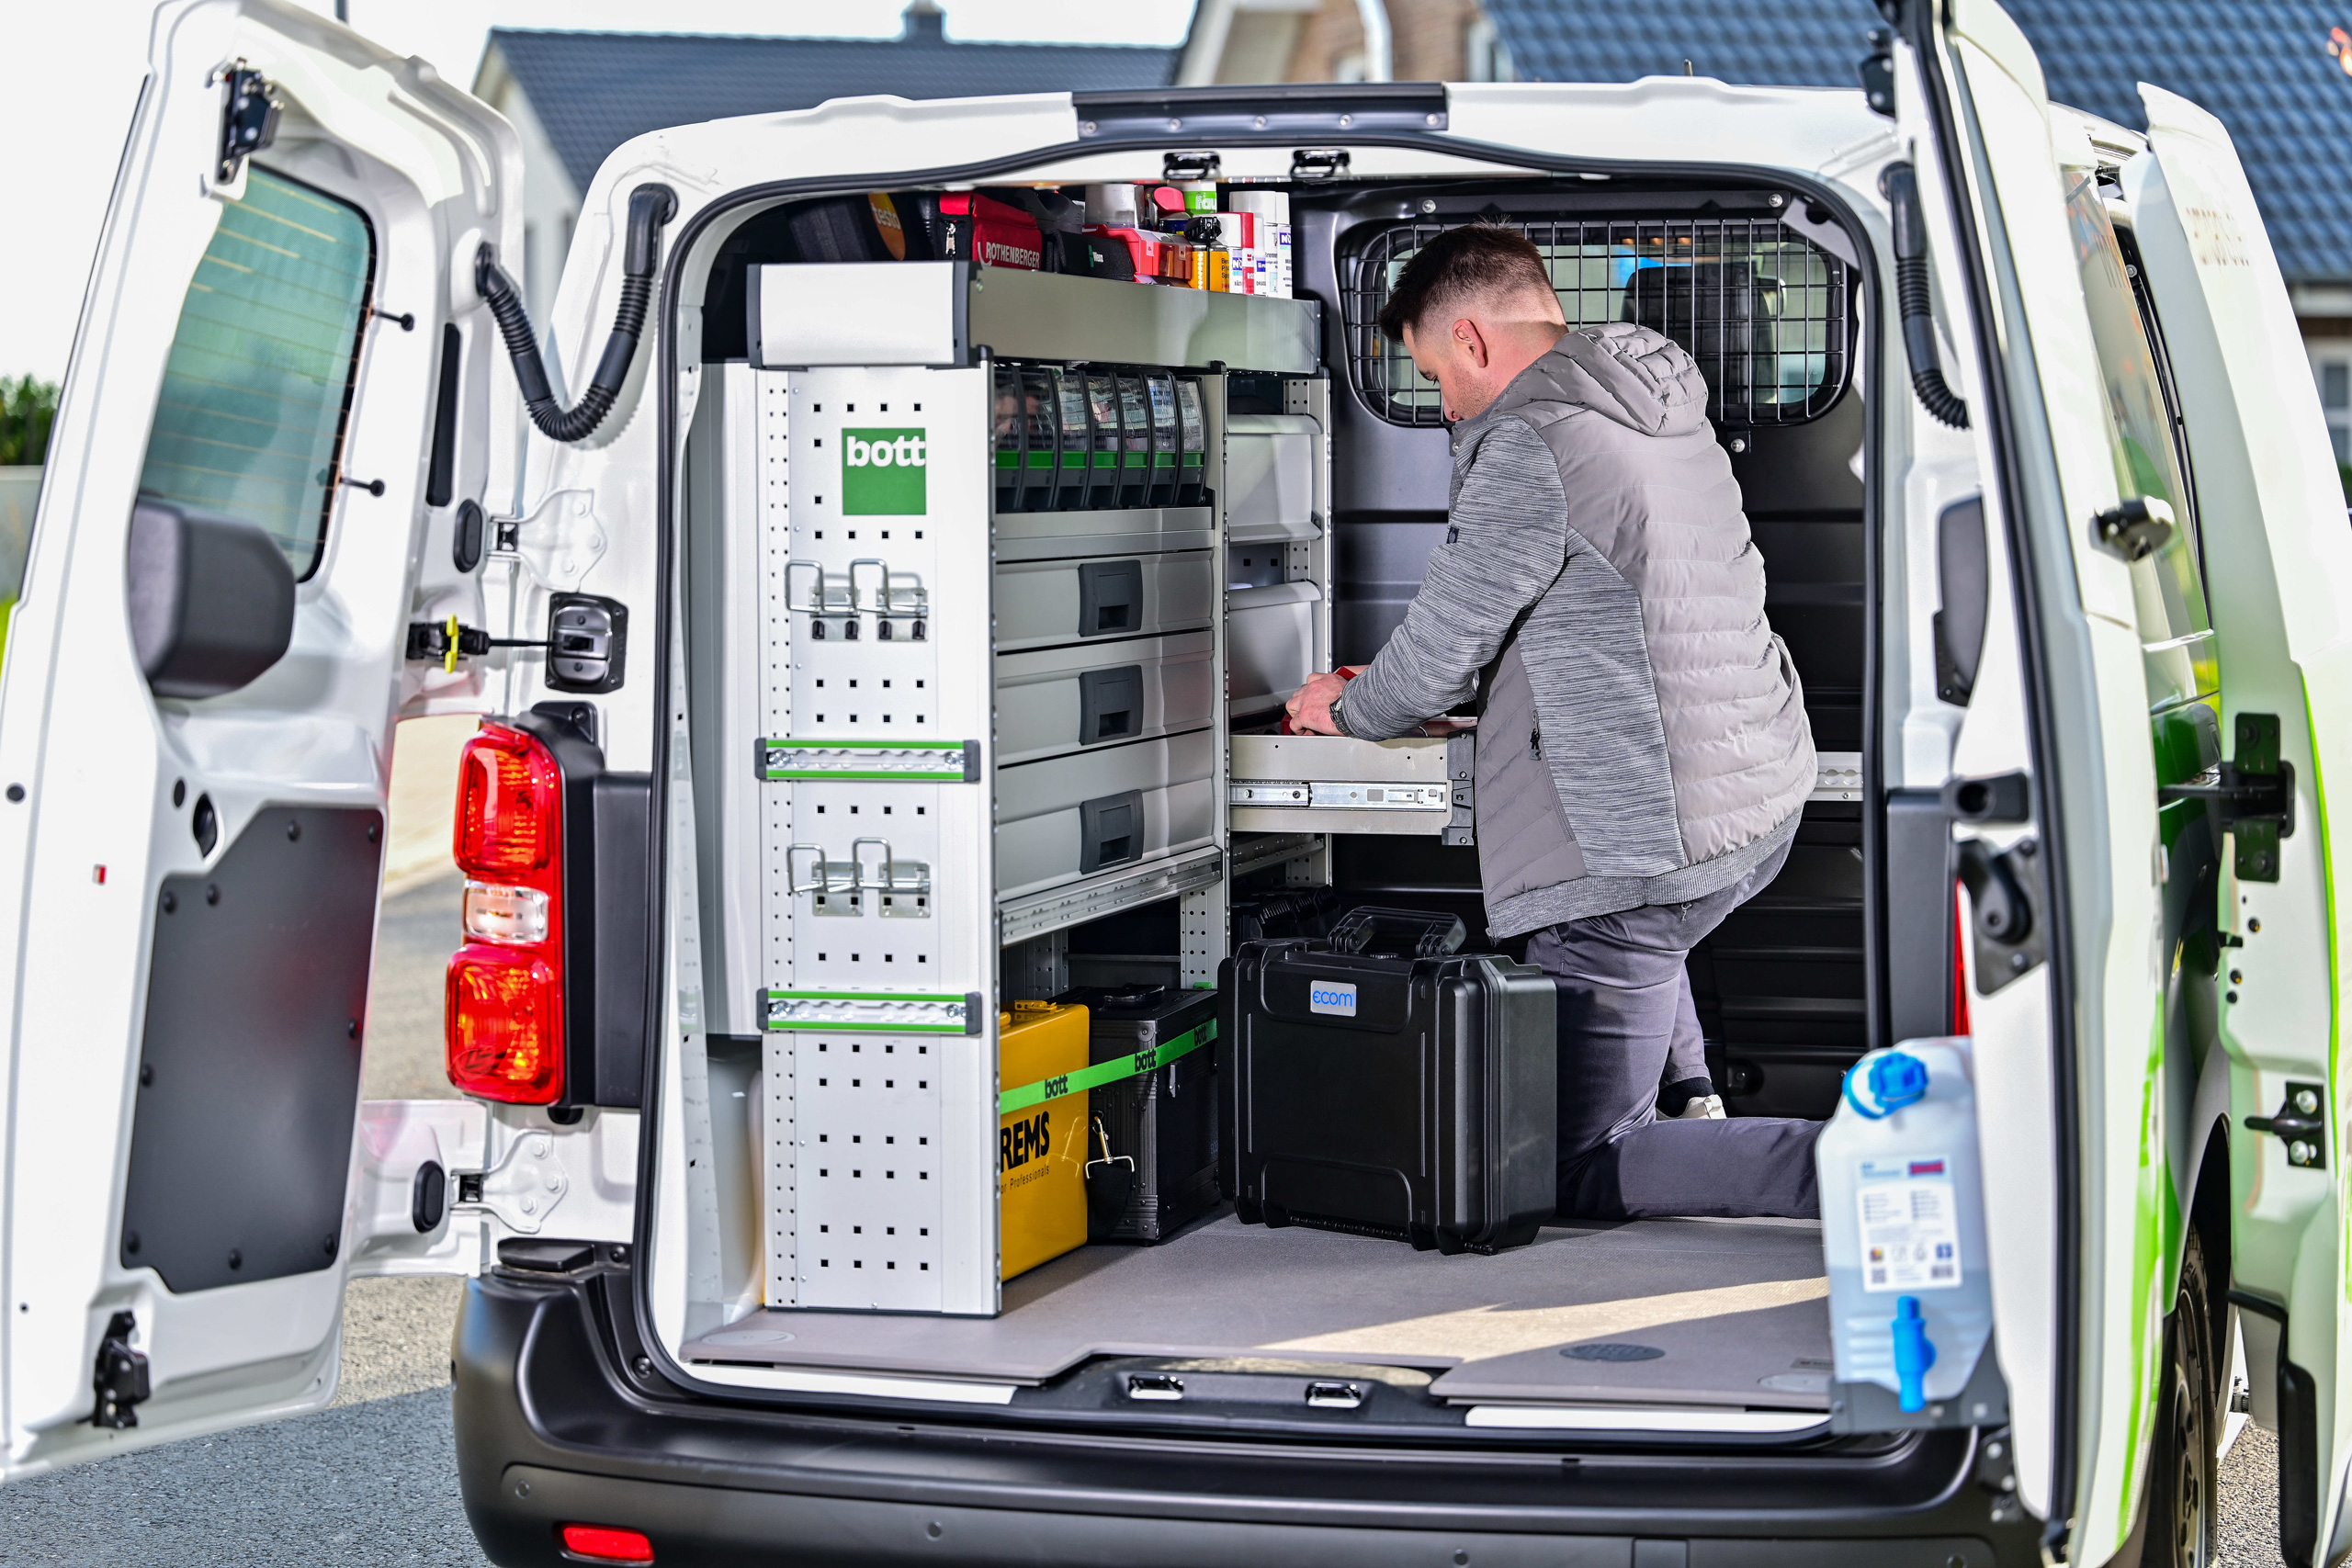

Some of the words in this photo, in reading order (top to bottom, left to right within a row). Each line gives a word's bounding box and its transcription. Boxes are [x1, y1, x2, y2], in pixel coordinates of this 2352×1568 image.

[871, 202, 901, 231] testo
[985, 241, 1040, 269] ROTHENBERGER
[847, 435, 926, 467] bott
[1312, 990, 1352, 1008] ecom
[1193, 1024, 1207, 1047] bott
[1135, 1048, 1157, 1073] bott
[1045, 1073, 1069, 1100] bott
[1001, 1111, 1050, 1173] REMS
[1010, 1164, 1050, 1190] Professionals
